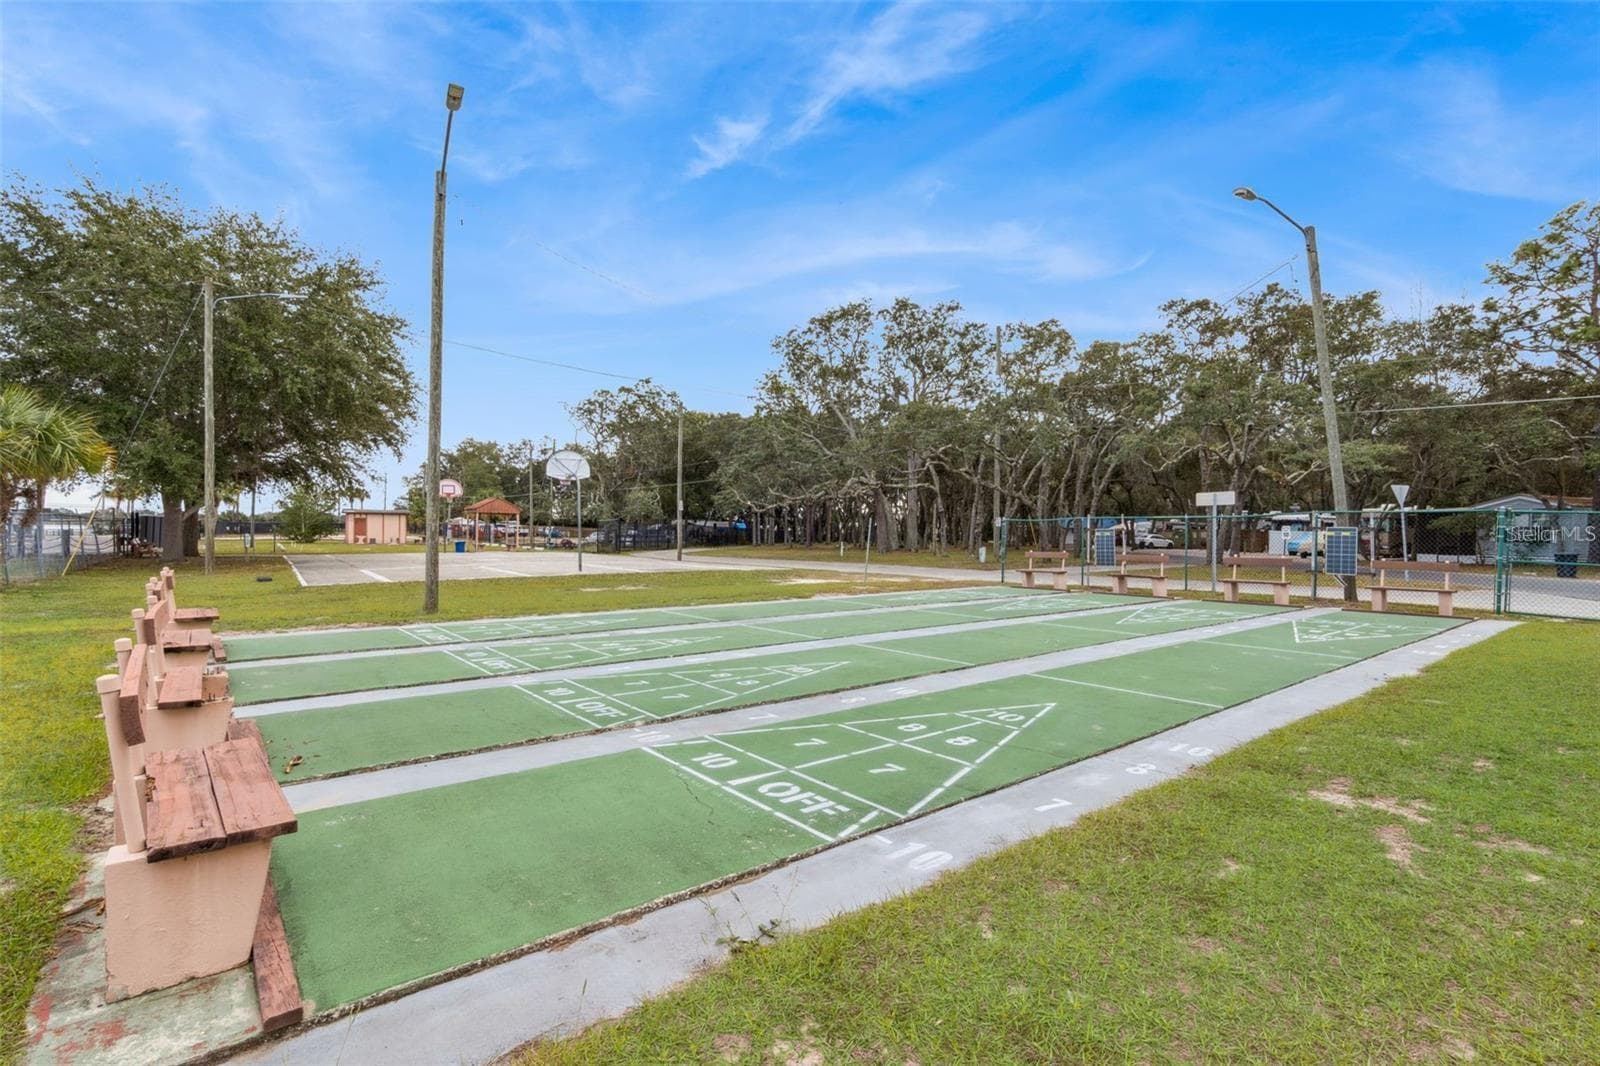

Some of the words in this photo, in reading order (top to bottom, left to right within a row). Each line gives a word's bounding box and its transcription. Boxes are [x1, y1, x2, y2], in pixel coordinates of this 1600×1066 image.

[575, 701, 629, 718] OFF
[986, 709, 1026, 722] 10
[897, 722, 928, 732] 8
[793, 738, 829, 747] 7
[945, 736, 978, 746] 8
[1167, 743, 1213, 757] 10
[691, 752, 738, 769] 10
[868, 763, 906, 774] 7
[1125, 763, 1157, 775] 8
[758, 782, 850, 815] OFF
[1033, 798, 1073, 813] 7
